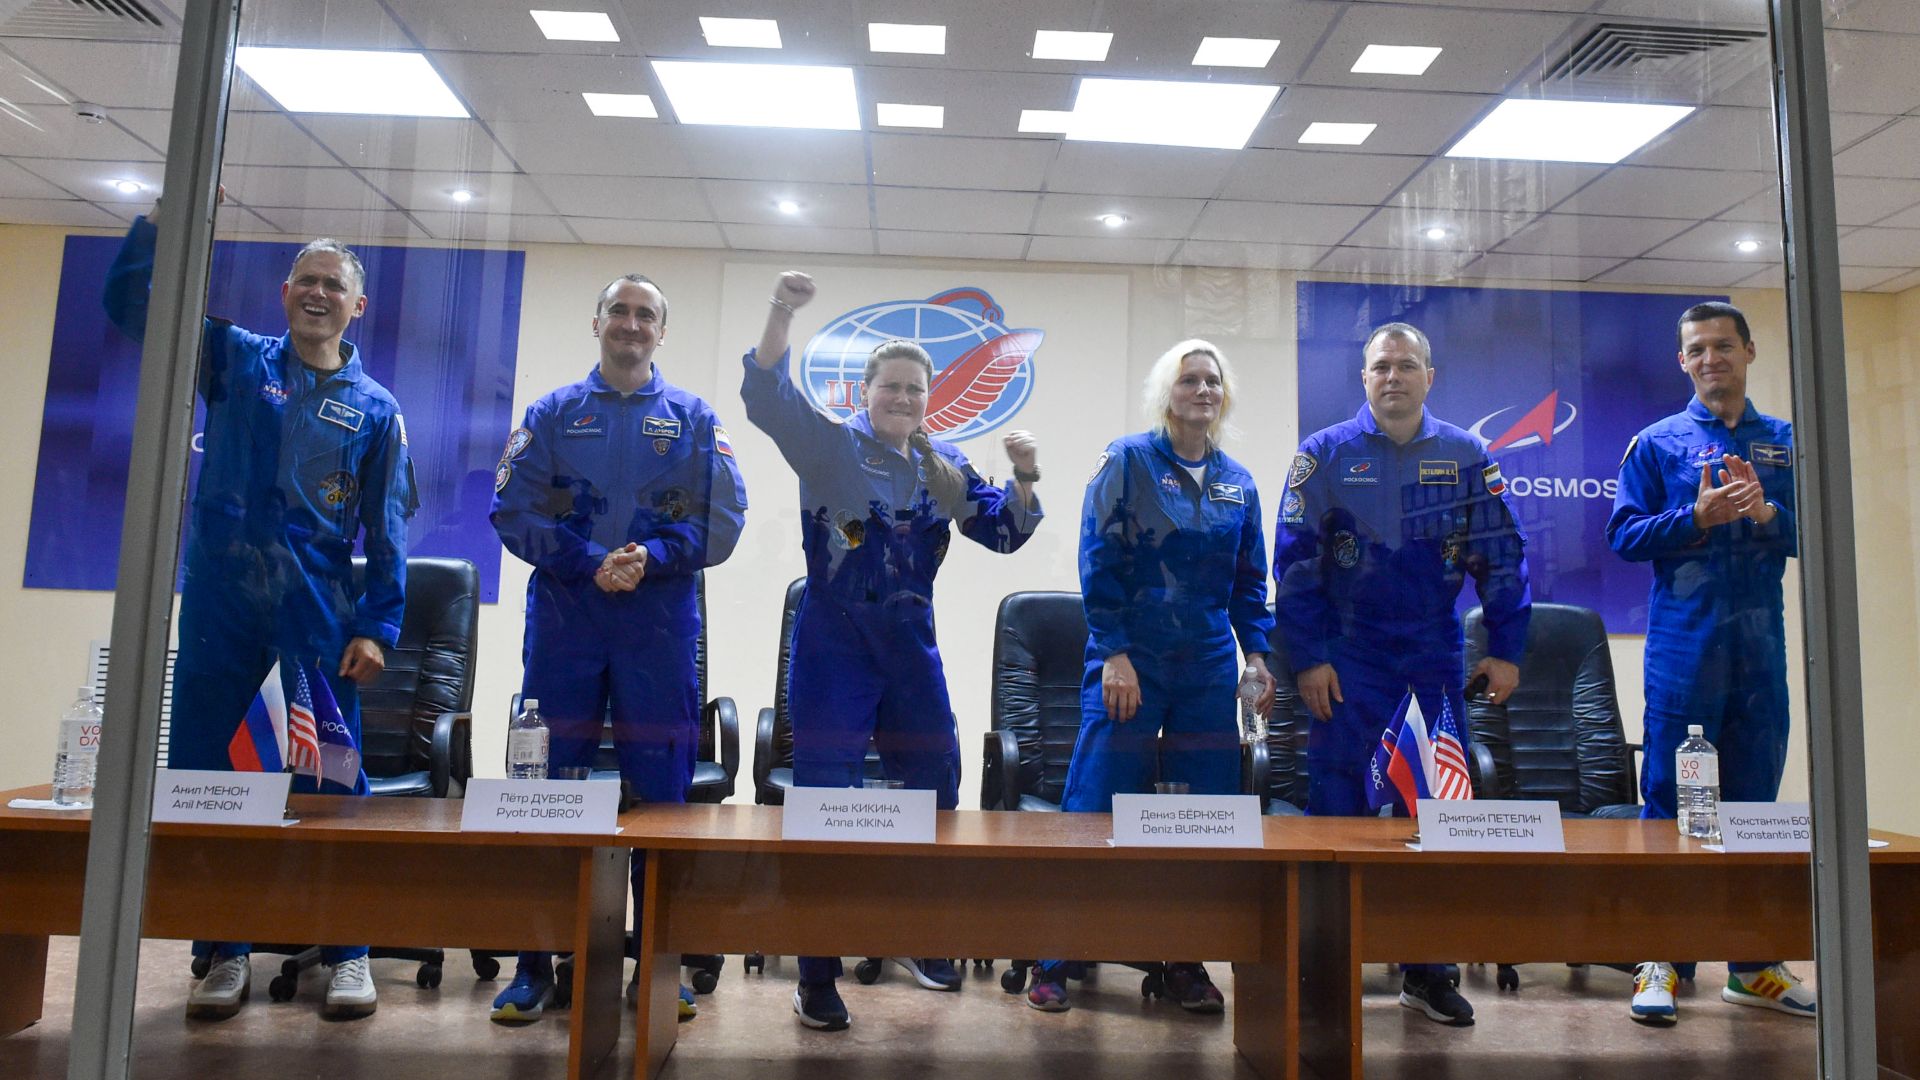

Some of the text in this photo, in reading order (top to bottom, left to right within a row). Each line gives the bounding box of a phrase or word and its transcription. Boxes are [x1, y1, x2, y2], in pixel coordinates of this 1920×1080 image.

[1501, 476, 1619, 499] OSMOS
[171, 784, 250, 797] Анил МЕНОН
[500, 792, 584, 805] Пётр ДУБРОВ
[172, 799, 243, 811] Anil MENON
[820, 802, 901, 814] Анна КИКИНА
[496, 807, 584, 819] Pyotr DUBROV
[1140, 808, 1235, 821] Дениз БЁРНХЕМ
[1438, 812, 1541, 824] Дмитрий ПЕТЕЛИН
[824, 817, 895, 829] Anna KIKINA
[1729, 816, 1790, 826] Константин
[1142, 824, 1235, 835] Deniz BURNHAM
[1449, 827, 1534, 839] Dmitry PETELIN
[1736, 830, 1792, 840] Konstantin
